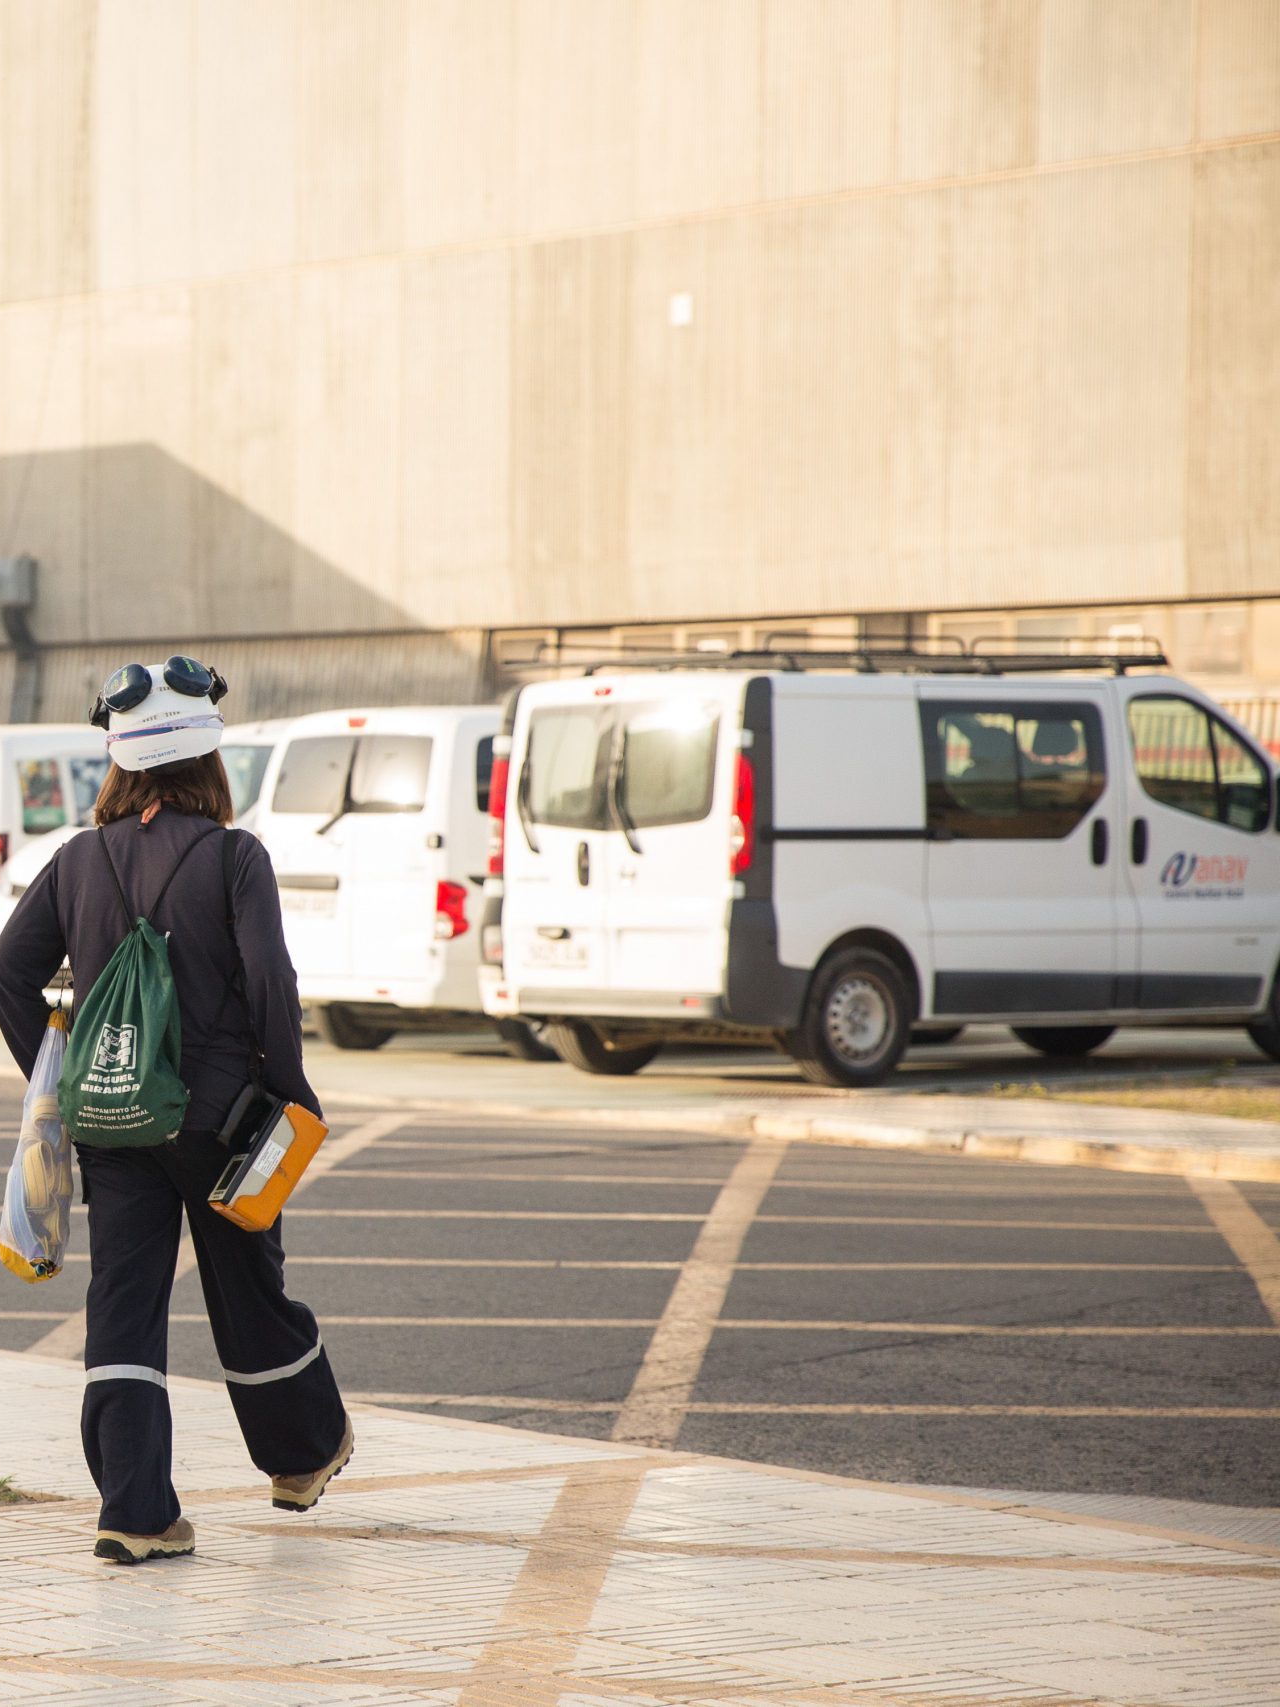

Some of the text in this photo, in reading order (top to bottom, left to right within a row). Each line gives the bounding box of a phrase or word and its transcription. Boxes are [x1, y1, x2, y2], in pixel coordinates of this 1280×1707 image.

[87, 1073, 135, 1084] MIGUEL
[80, 1083, 141, 1094] MIRANDA
[130, 1104, 140, 1112] DE
[117, 1109, 149, 1121] LABORAL
